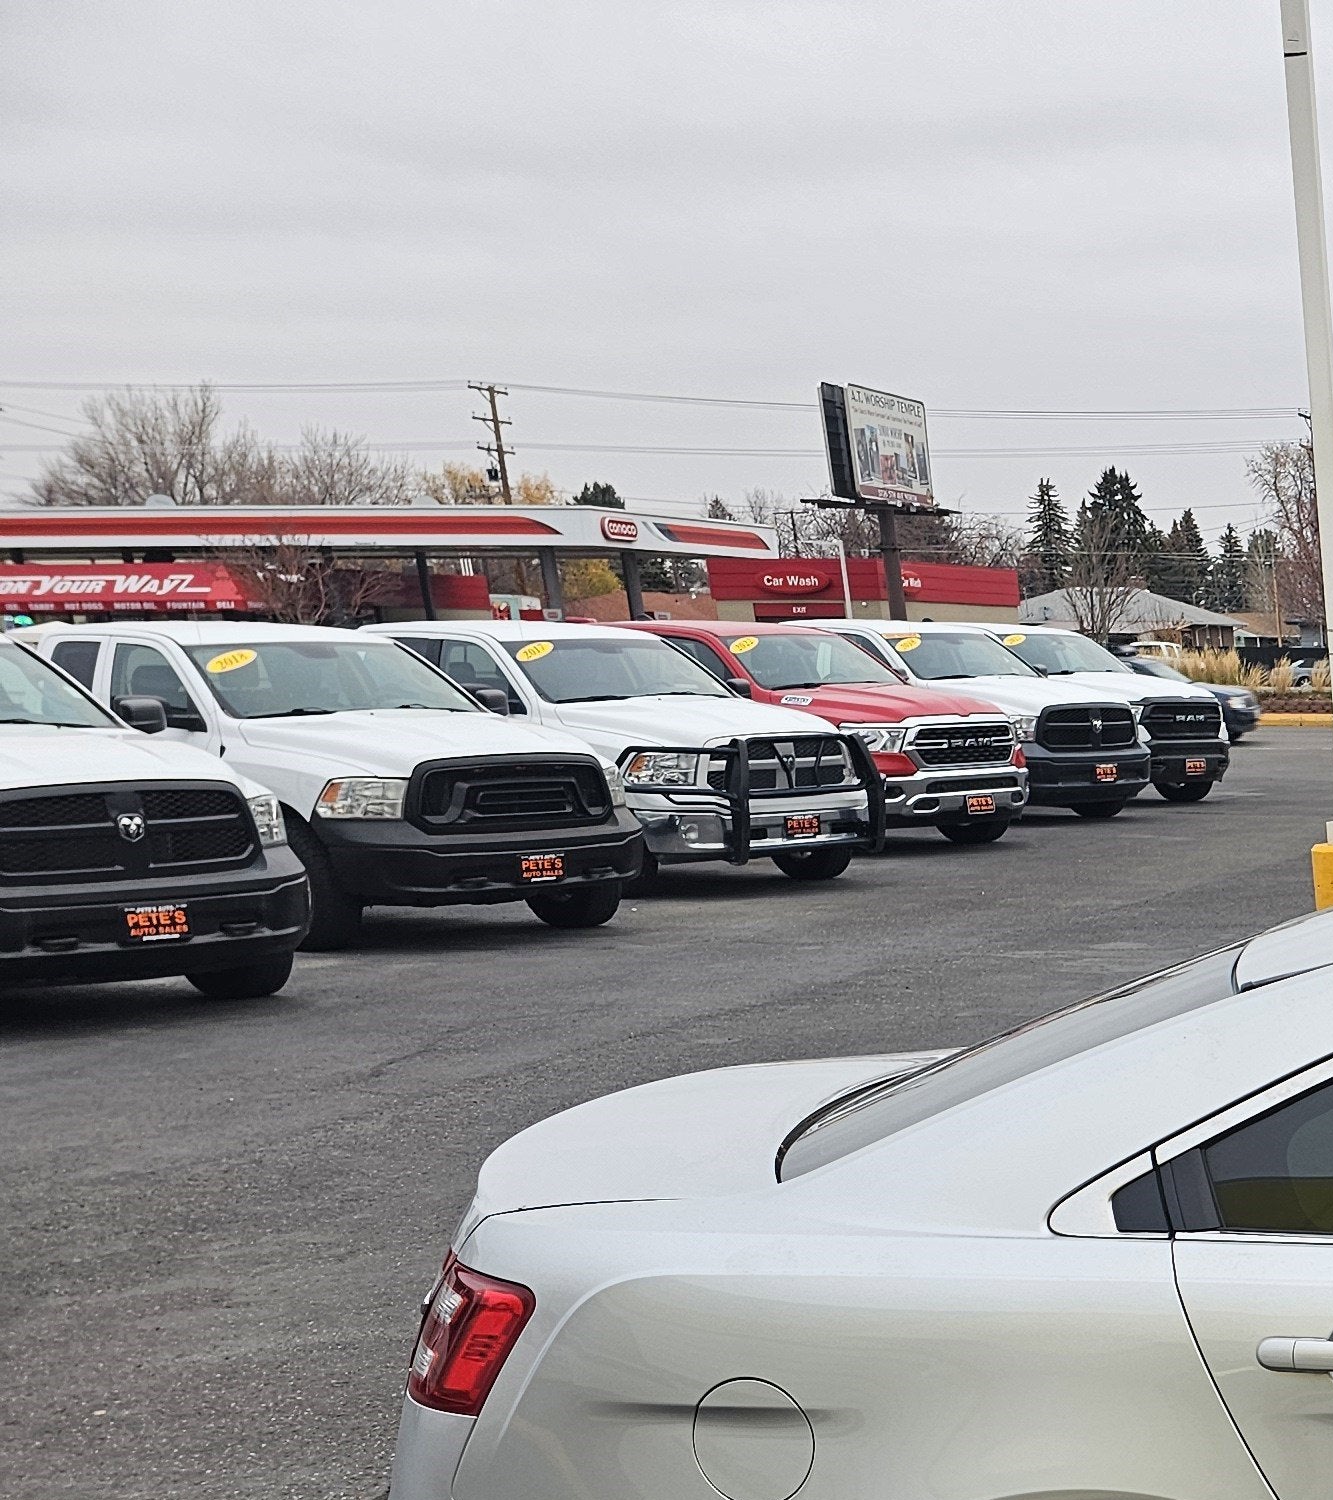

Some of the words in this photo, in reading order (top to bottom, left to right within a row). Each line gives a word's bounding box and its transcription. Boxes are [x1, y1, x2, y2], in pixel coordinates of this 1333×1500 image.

[897, 401, 921, 418] TEMPLE
[763, 575, 783, 587] Car
[786, 574, 819, 587] Wash
[787, 818, 819, 829] PETE'S
[521, 858, 563, 871] PETE'S
[126, 910, 187, 928] PETE'S
[130, 926, 157, 937] AUTO
[158, 924, 189, 934] SALES
